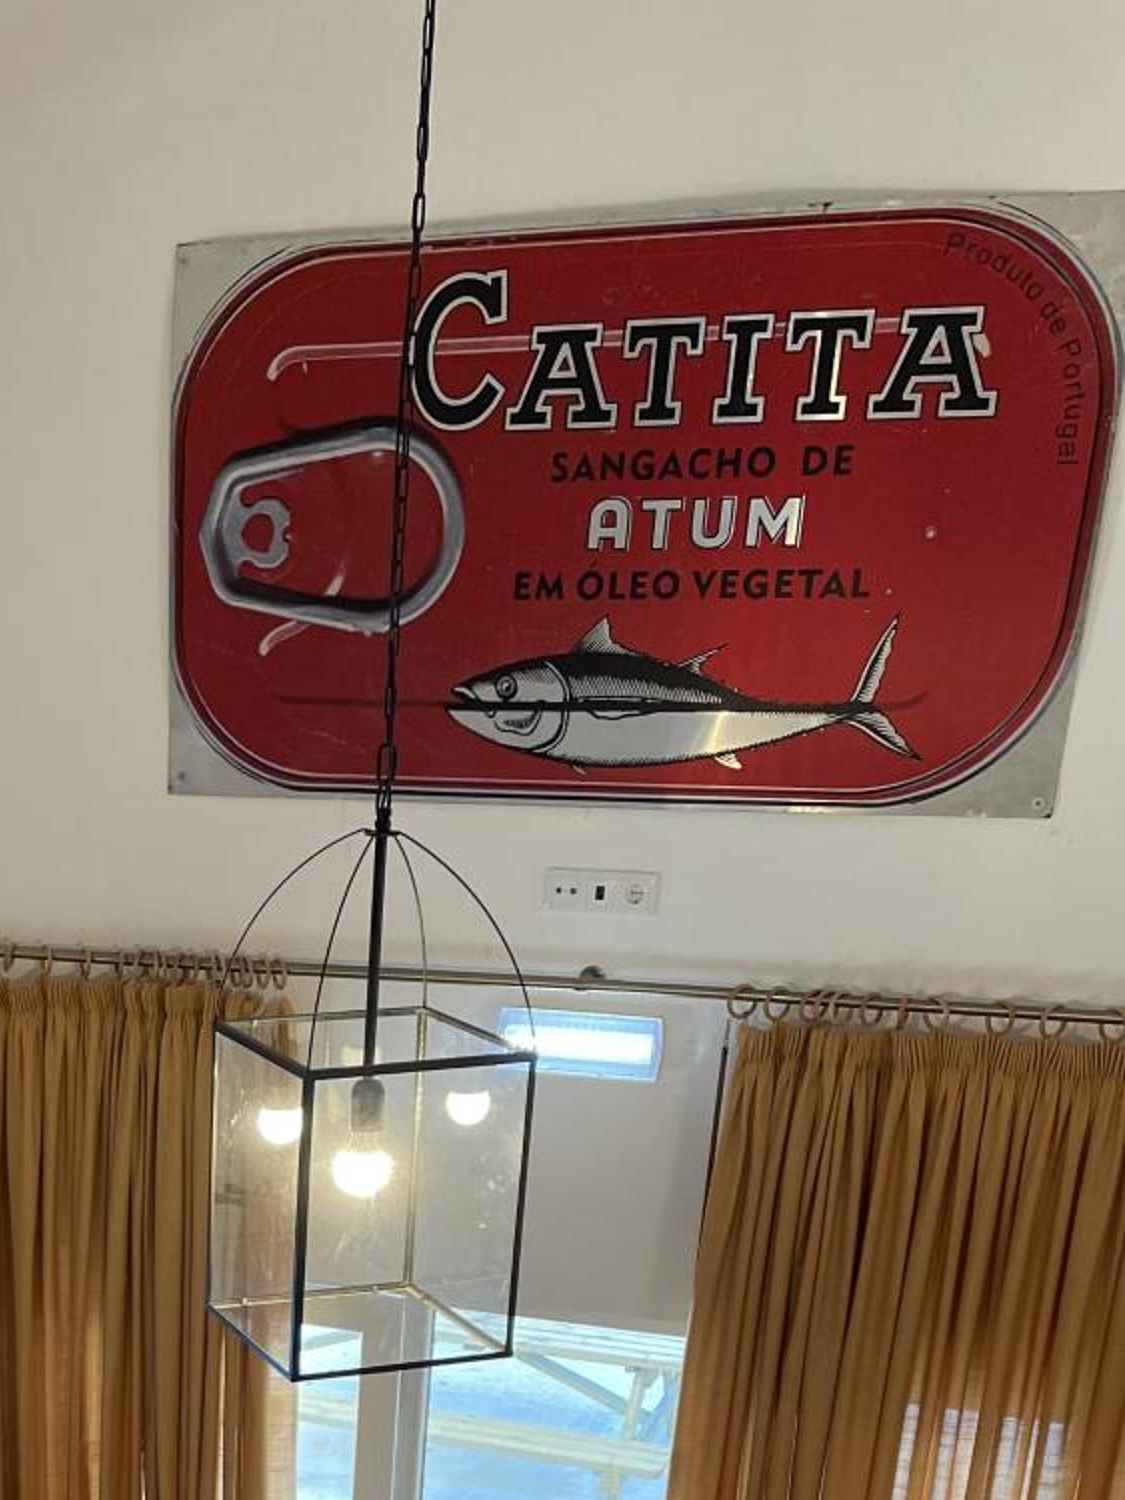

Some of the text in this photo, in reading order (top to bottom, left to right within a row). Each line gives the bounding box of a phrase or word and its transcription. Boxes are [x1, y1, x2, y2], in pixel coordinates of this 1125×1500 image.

[408, 268, 998, 432] CATITA
[942, 230, 1086, 465] Produto de Portugal
[550, 443, 856, 483] SANGACHO DE
[586, 493, 807, 551] ATUM
[513, 563, 871, 601] EM ÓLEO VEGETAL
